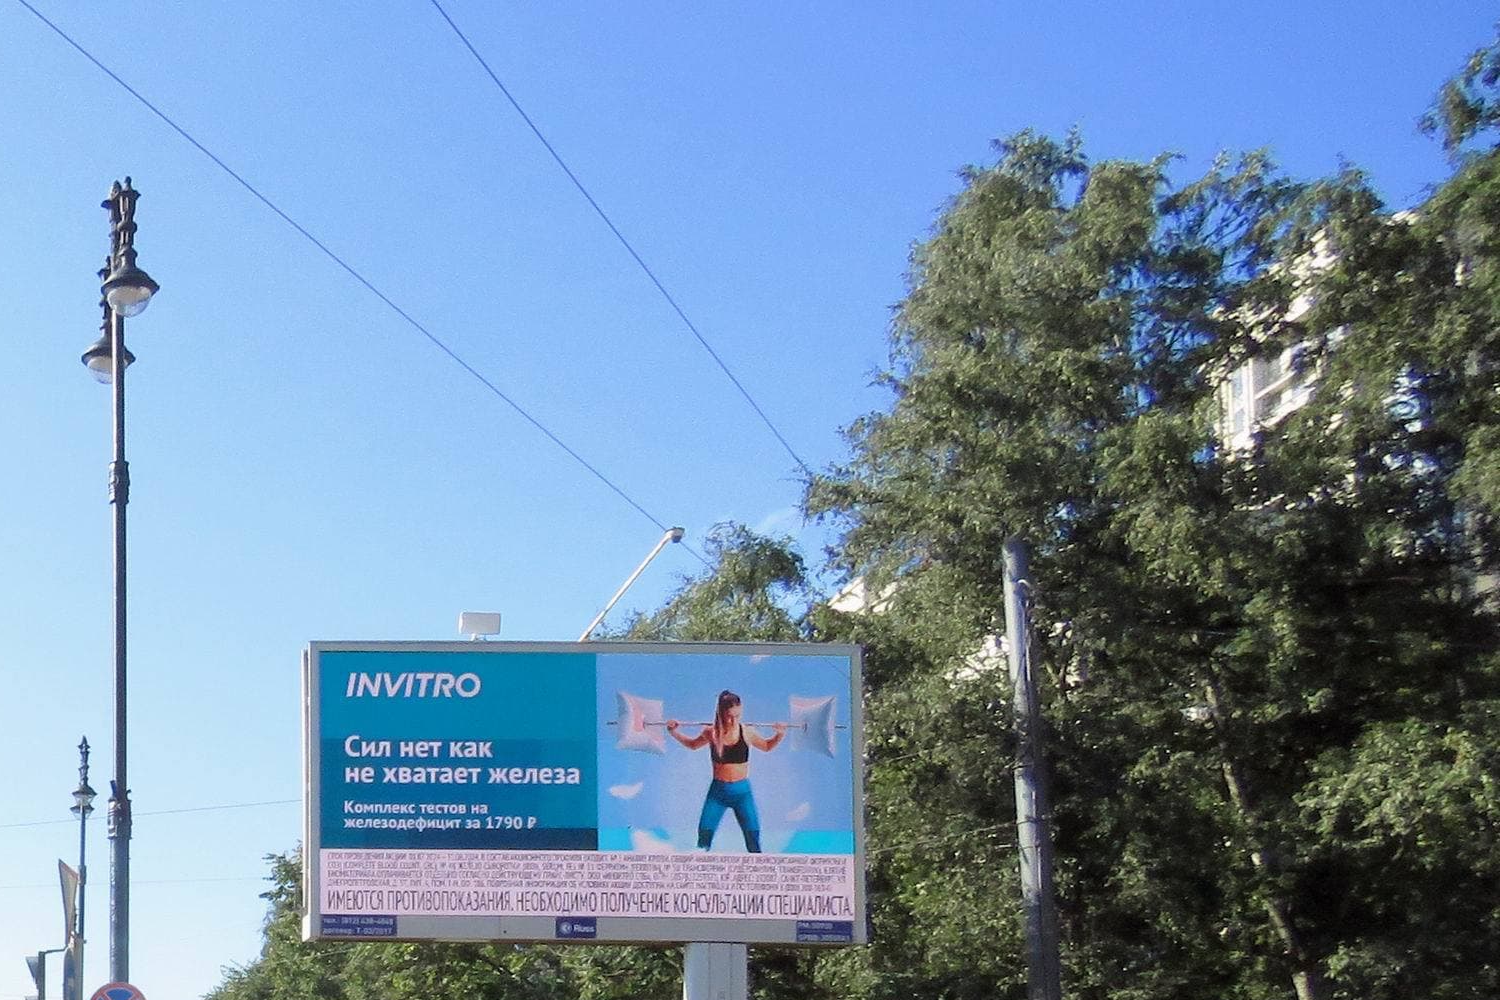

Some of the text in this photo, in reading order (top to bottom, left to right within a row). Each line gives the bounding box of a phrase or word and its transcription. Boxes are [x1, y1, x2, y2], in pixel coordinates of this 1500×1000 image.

[345, 672, 482, 698] INVITRO
[344, 735, 493, 758] Сил нет как
[344, 766, 580, 784] не хватает железа
[344, 800, 488, 814] Комплекс тестов на
[343, 816, 462, 831] железодефицит
[466, 819, 481, 829] за
[486, 816, 522, 829] 1790
[327, 890, 854, 917] ИМЕЮТСЯ ПРОТИВОПОКАЗАНИЯ. НЕОБХОДИМО ПОЛУЧЕНИЕ КОНСУЛЬТАЦИИ СПЕЦИАЛИСТА.
